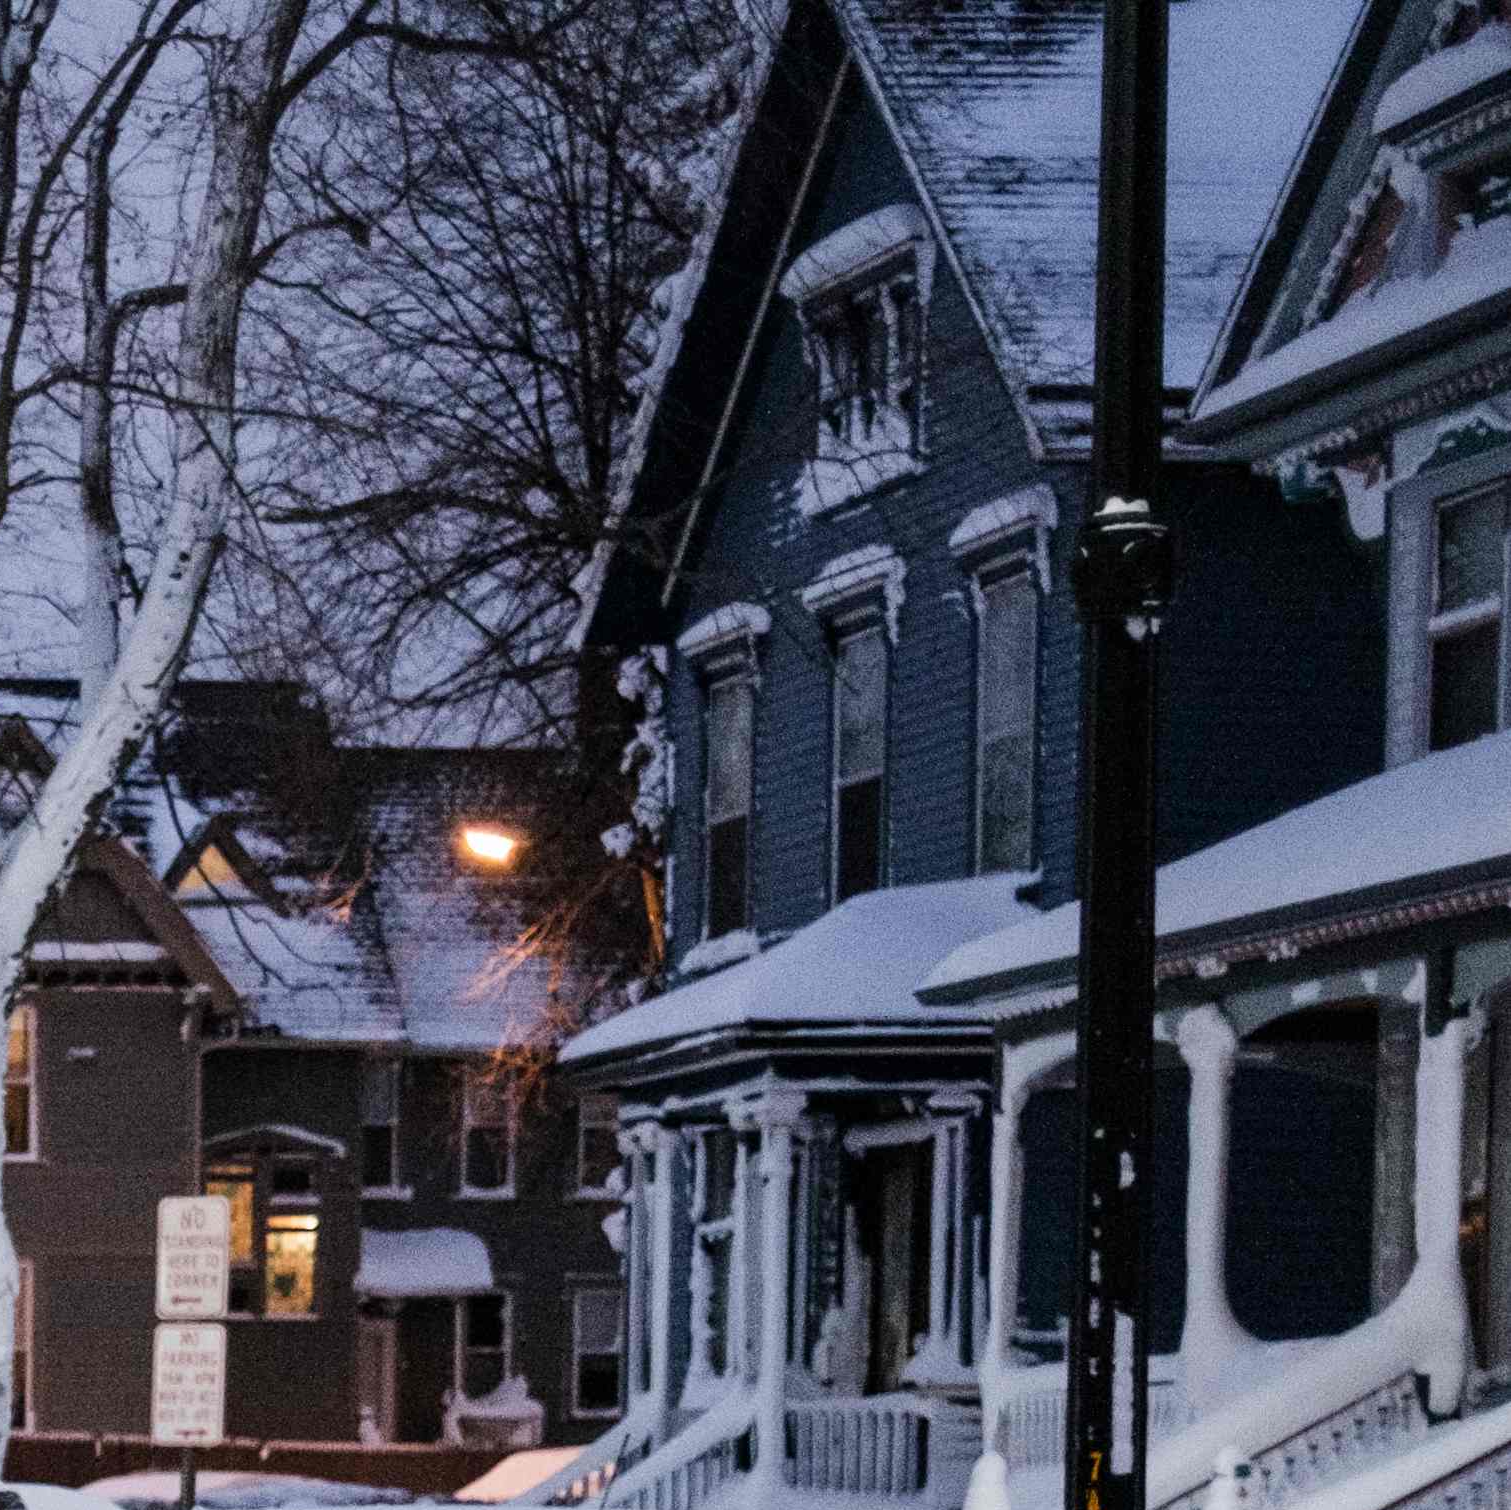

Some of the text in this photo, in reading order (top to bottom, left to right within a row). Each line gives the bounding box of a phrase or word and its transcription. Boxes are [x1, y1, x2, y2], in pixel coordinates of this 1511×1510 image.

[180, 1206, 205, 1229] NO
[205, 1254, 219, 1268] TO
[166, 1274, 218, 1288] CORNER
[180, 1331, 199, 1345] NO
[161, 1351, 217, 1366] PARKING
